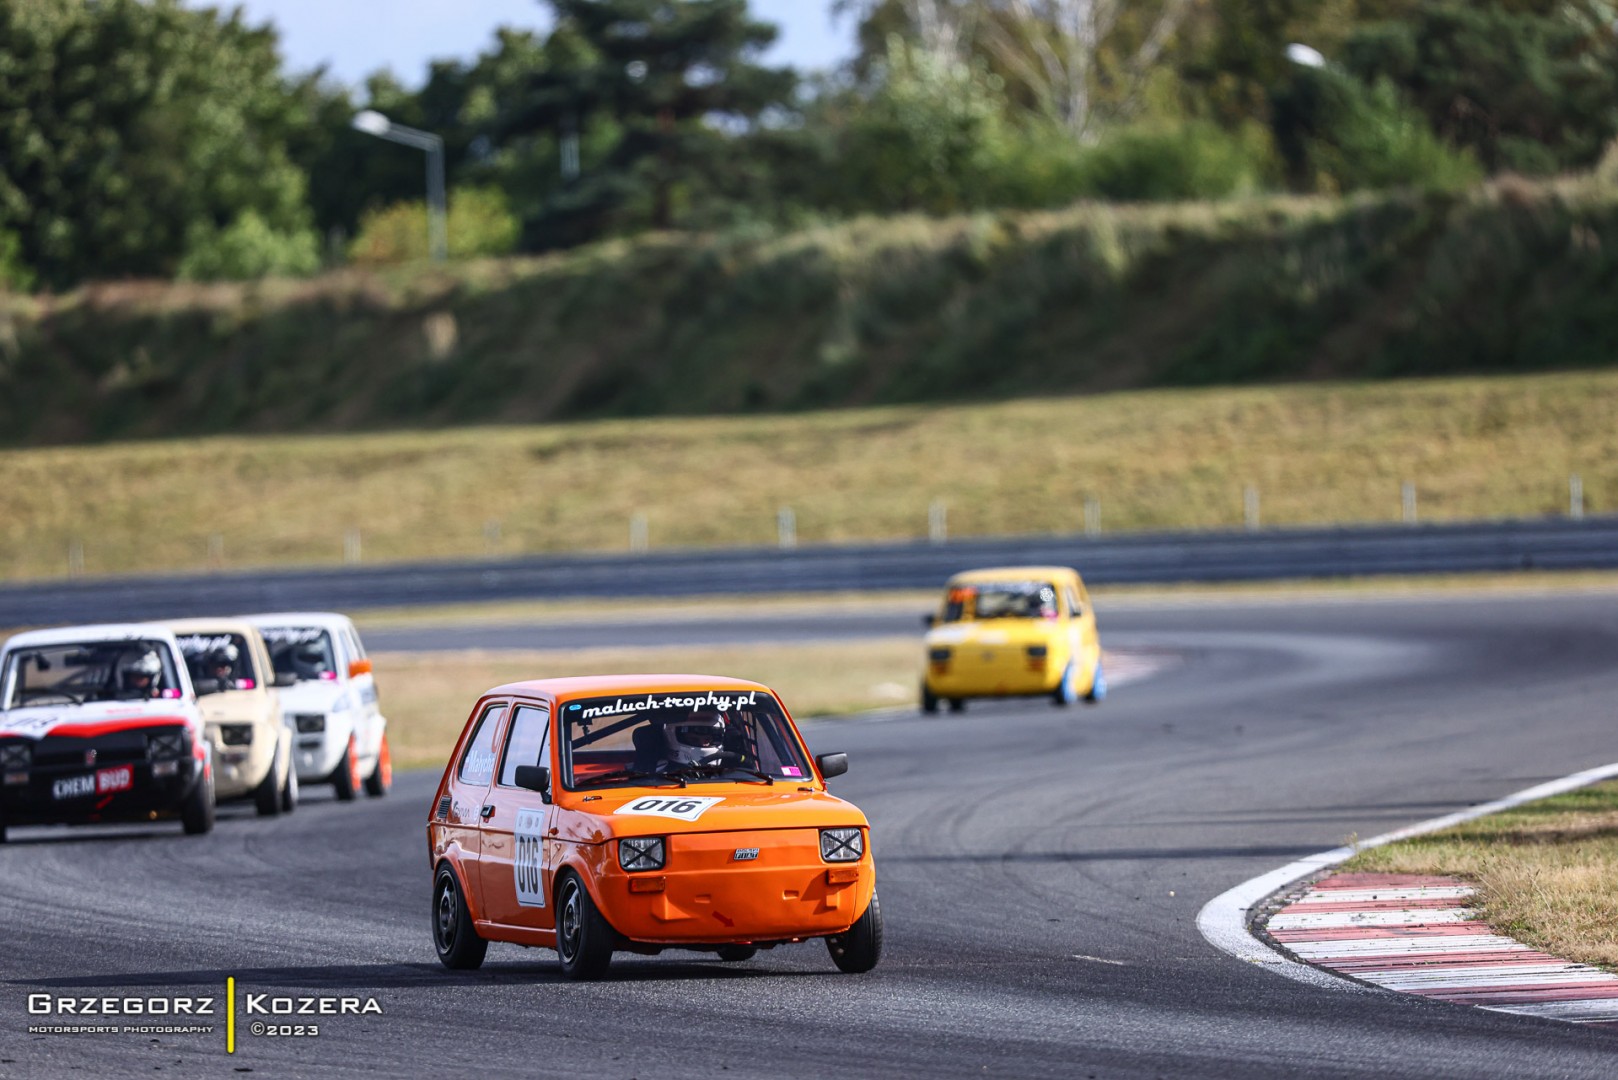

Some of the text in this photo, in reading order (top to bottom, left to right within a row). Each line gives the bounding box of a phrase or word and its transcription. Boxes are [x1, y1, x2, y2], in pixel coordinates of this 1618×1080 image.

[582, 691, 758, 719] maluch-trophy.pl
[53, 769, 131, 799] CHEM BUD
[632, 800, 703, 814] 016
[517, 835, 539, 894] 016
